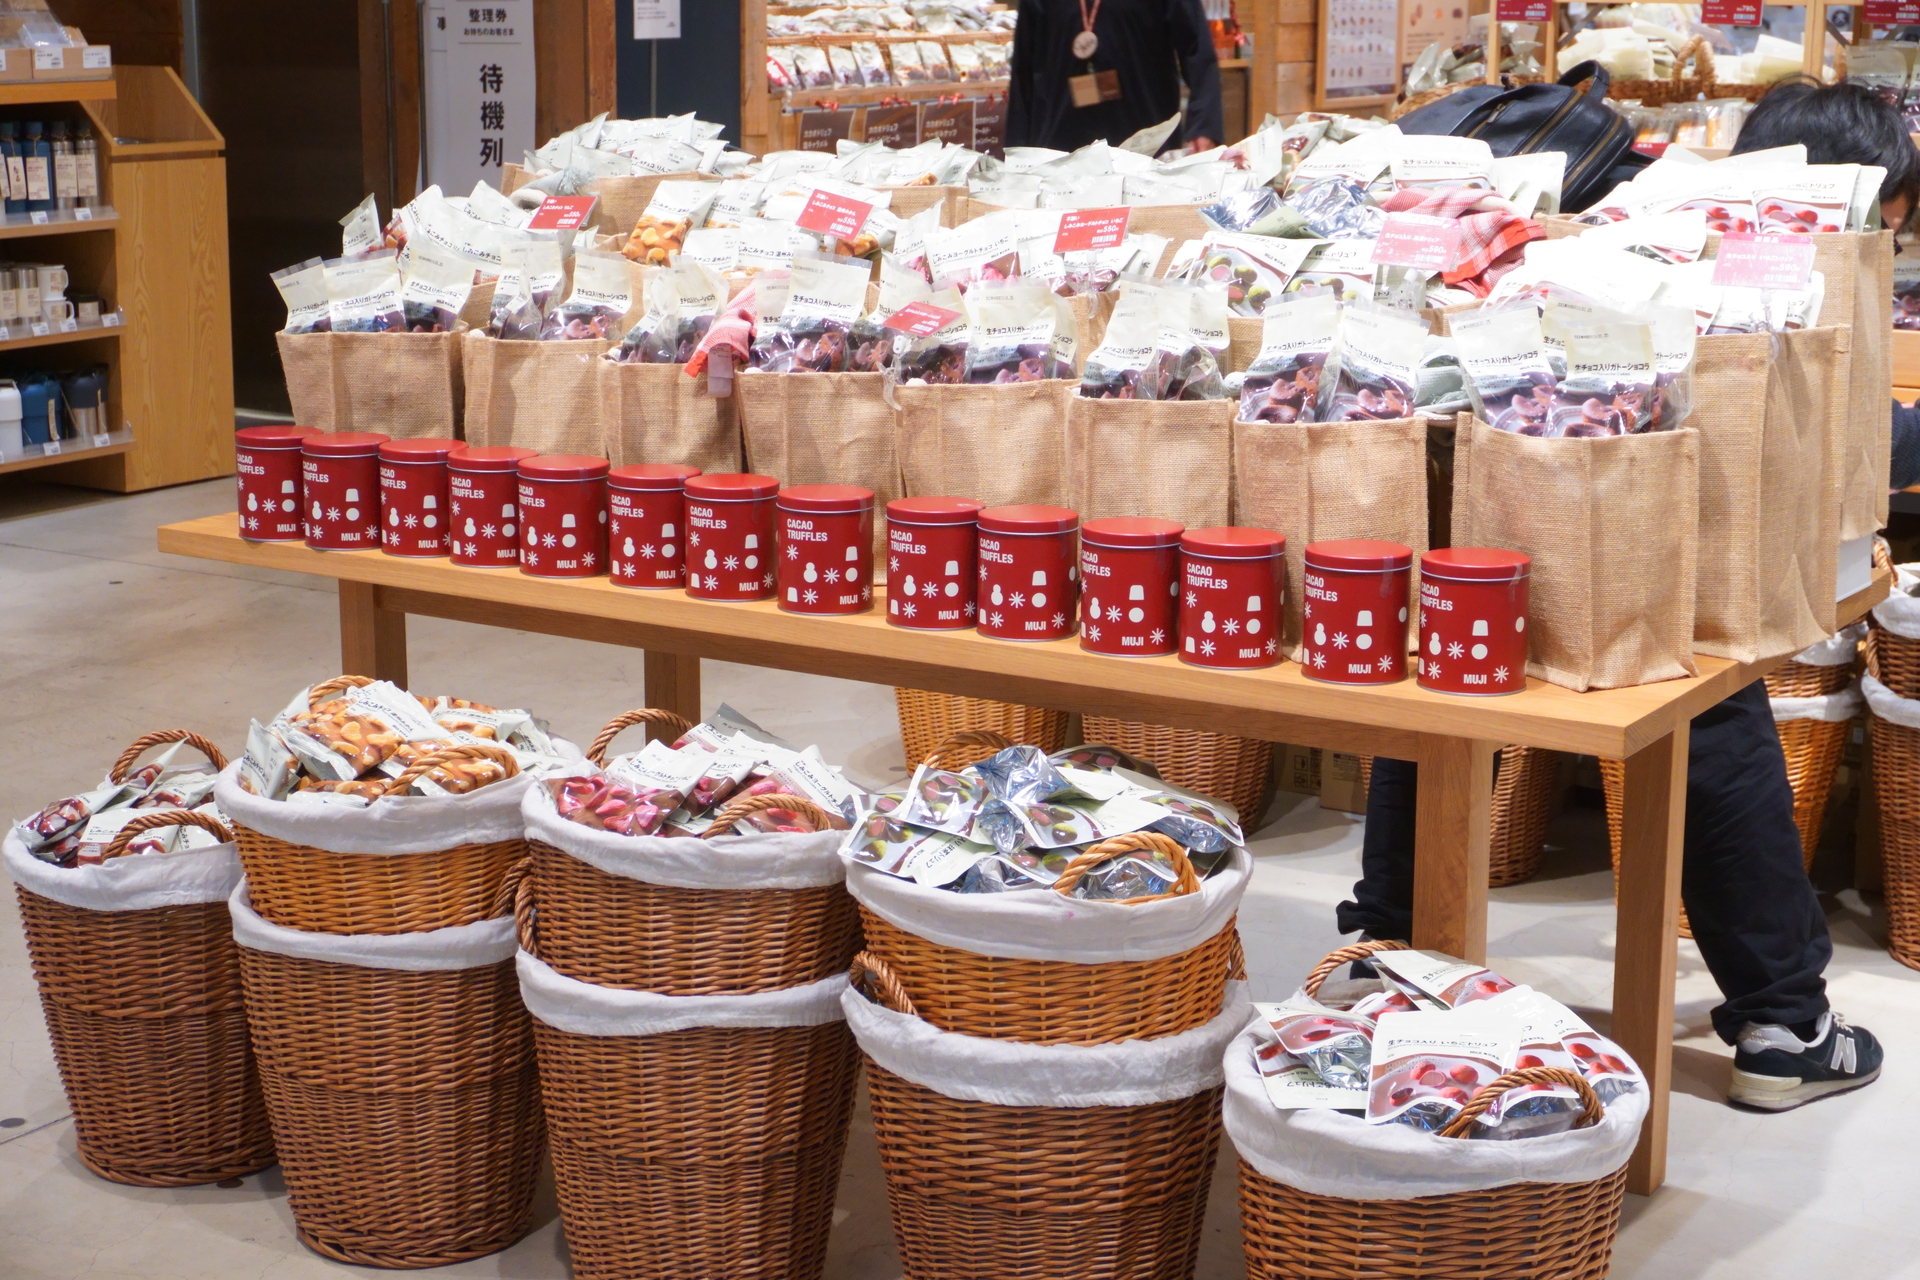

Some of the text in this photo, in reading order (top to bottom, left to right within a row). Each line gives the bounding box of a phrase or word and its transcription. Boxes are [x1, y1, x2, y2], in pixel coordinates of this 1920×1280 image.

[468, 7, 507, 23] 整理券
[463, 27, 514, 36] お持ちのお客さま
[479, 63, 504, 167] 待機列
[425, 227, 453, 248] みこみチョコ
[576, 288, 628, 301] 生チョコ入りガトーショコラ
[986, 323, 1050, 336] 生チョコ入りガトーショコラ
[1575, 362, 1651, 372] 生チョコ入りガトーショコラ
[237, 453, 253, 464] CACAO
[237, 463, 265, 475] TRUFFLES
[303, 461, 318, 472] CACAO
[380, 467, 395, 478] CACAO
[303, 471, 329, 483] TRUFFLES
[452, 477, 471, 488] CACAO
[380, 477, 406, 490] TRUFFLES
[452, 487, 485, 498] TRUFFLES
[519, 484, 534, 496] CACAO
[518, 494, 545, 508] TRUFFLES
[611, 495, 630, 506] CACAO
[611, 505, 644, 518] TRUFFLES
[690, 506, 713, 517] CACAO
[277, 524, 296, 532] MUJI
[690, 516, 727, 529] TRUFFLES
[787, 519, 813, 530] CACAO
[341, 533, 360, 541] MUJI
[787, 529, 828, 541] TRUFFLES
[891, 530, 912, 542] CACAO
[418, 540, 438, 548] MUJI
[891, 540, 926, 554] TRUFFLES
[980, 538, 1000, 551] CACAO
[497, 549, 516, 558] MUJI
[980, 549, 1013, 564] TRUFFLES
[1082, 550, 1098, 563] CACAO
[557, 560, 577, 568] MUJI
[1081, 561, 1111, 577] TRUFFLES
[1187, 563, 1212, 576] CACAO
[656, 570, 676, 579] MUJI
[1306, 573, 1324, 587] CACAO
[739, 582, 758, 591] MUJI
[1187, 574, 1228, 589] TRUFFLES
[1306, 585, 1338, 602] TRUFFLES
[1421, 582, 1439, 597] CACAO
[840, 595, 858, 604] MUJI
[1420, 594, 1453, 611] TRUFFLES
[938, 610, 959, 619] MUJI
[1025, 621, 1046, 630] MUJI
[1122, 637, 1144, 646] MUJI
[1239, 648, 1260, 658] MUJI
[1348, 664, 1371, 674] MUJI
[1464, 674, 1487, 684] MUJI
[1387, 1038, 1437, 1046] 生チョコ入り
[1830, 1034, 1857, 1074] N
